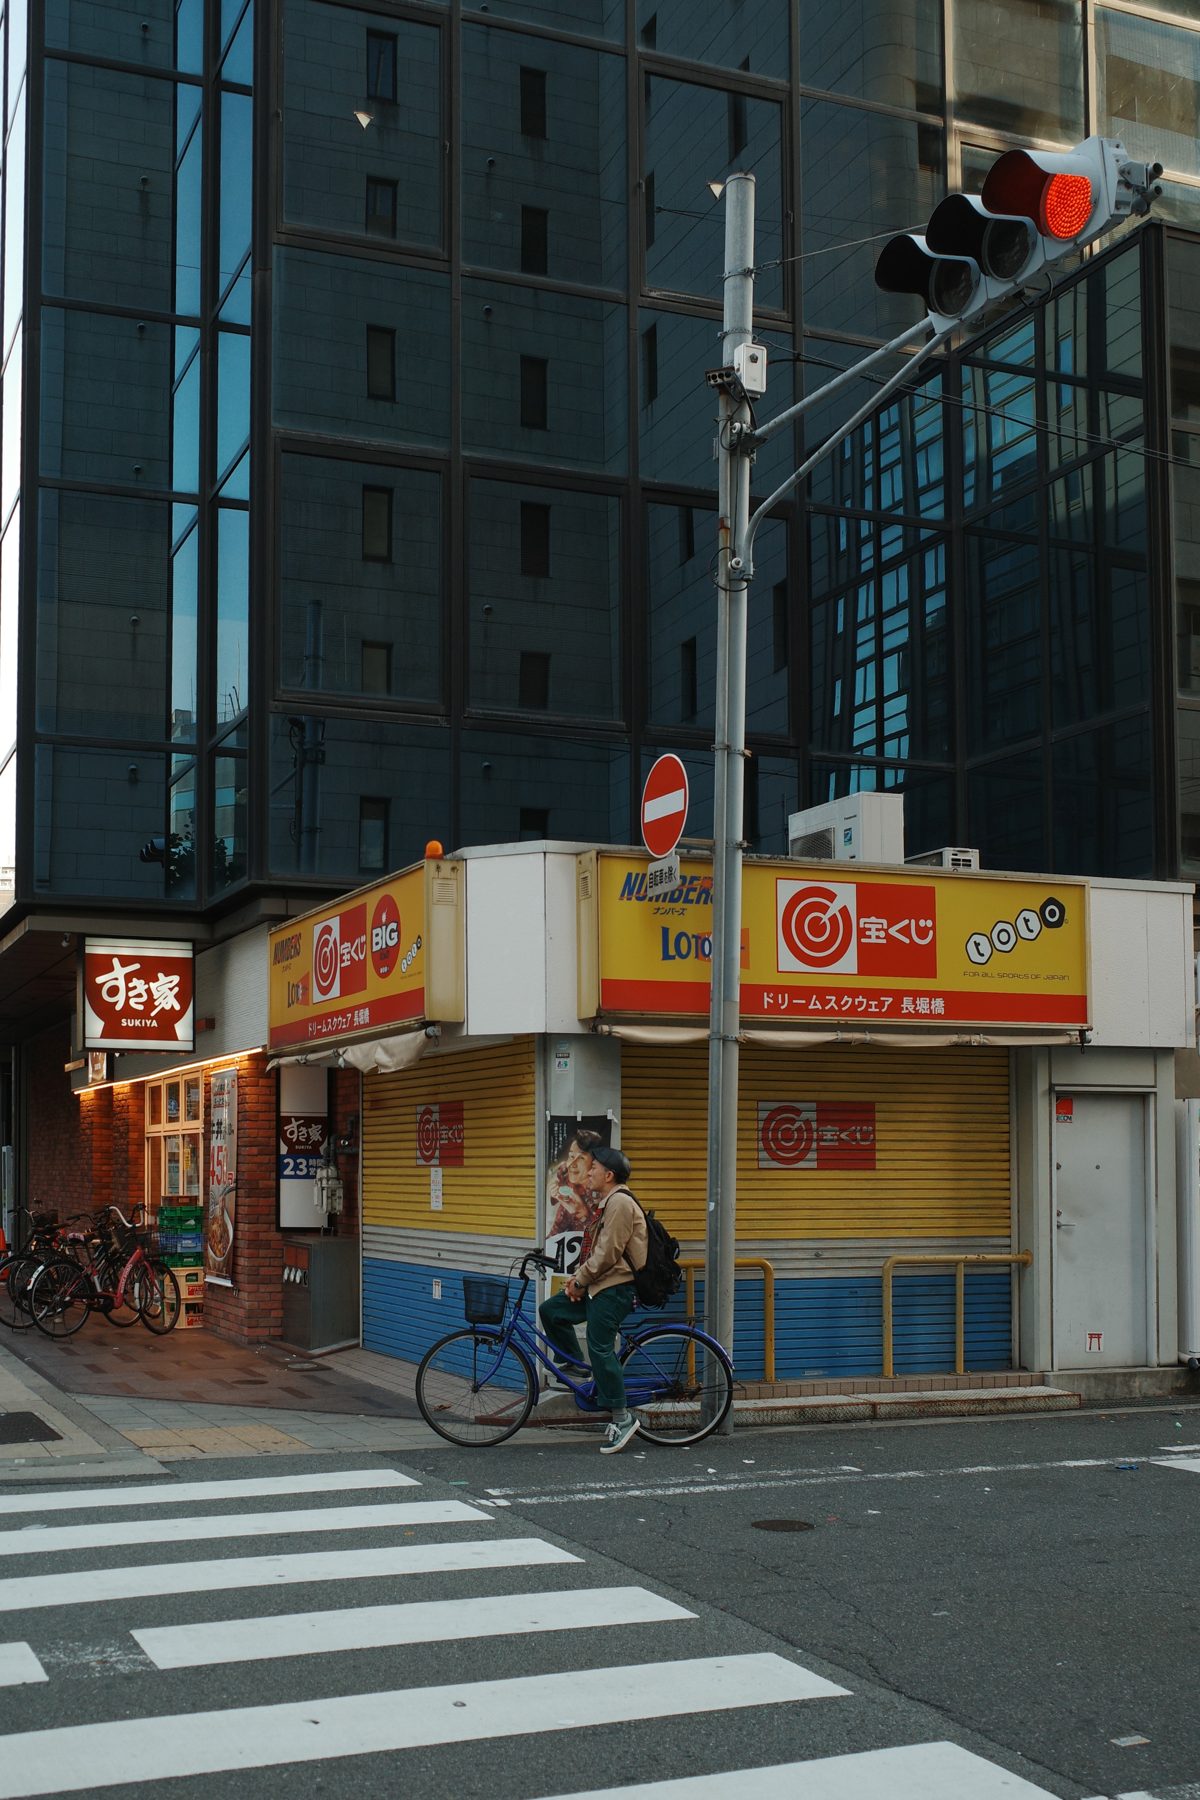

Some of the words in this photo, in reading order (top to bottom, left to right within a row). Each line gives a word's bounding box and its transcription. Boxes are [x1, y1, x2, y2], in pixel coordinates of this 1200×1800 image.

[652, 907, 687, 916] ナンバーズ
[371, 921, 399, 953] BIG
[859, 916, 934, 945] 宝くじ
[971, 902, 1062, 960] toto
[340, 934, 367, 968] 宝くじ
[95, 957, 181, 1017] すき家
[762, 992, 893, 1012] ドリームスクウェア
[900, 997, 945, 1015] 長堀橋
[121, 1018, 158, 1028] SUKIYA
[308, 1013, 352, 1036] ドリームスクウェア
[353, 1008, 370, 1026] 長堀橋
[283, 1117, 322, 1144] すき家
[818, 1125, 874, 1146] 宝くじ
[283, 1158, 308, 1176] 23
